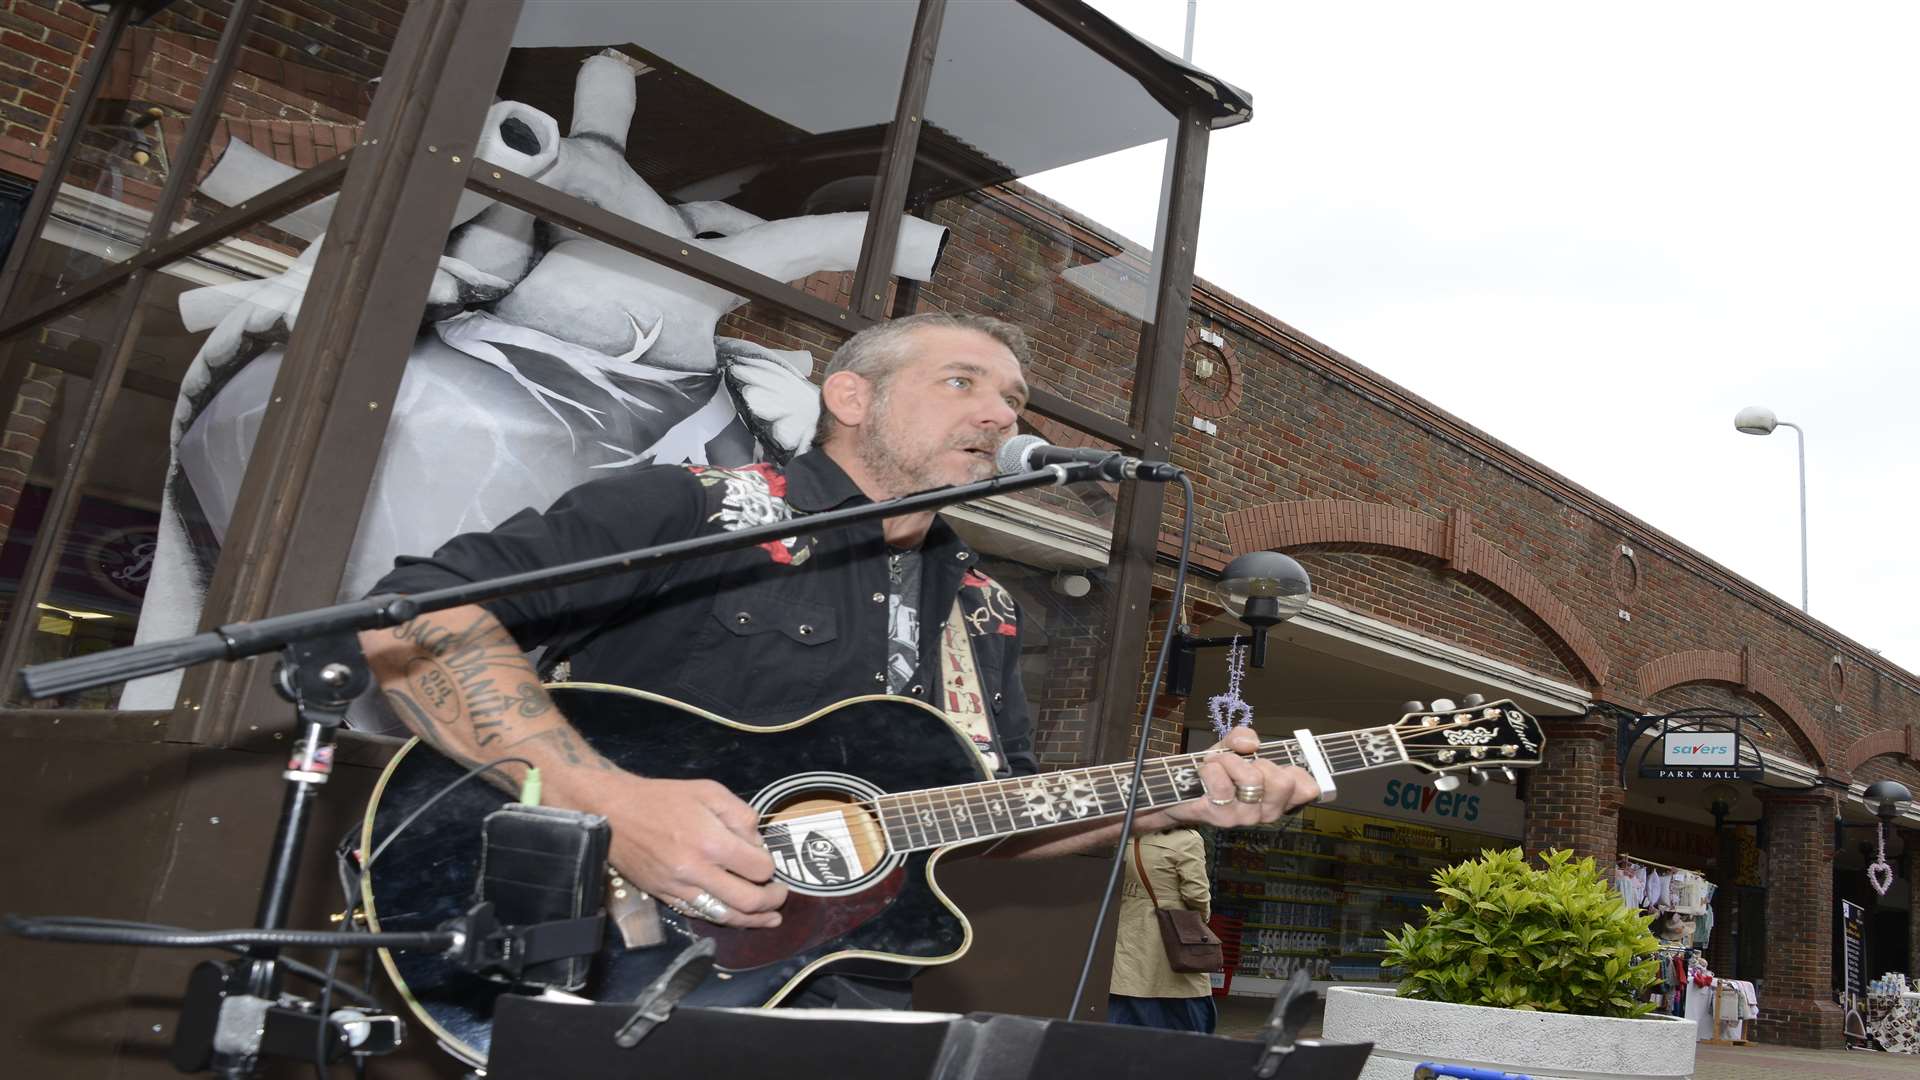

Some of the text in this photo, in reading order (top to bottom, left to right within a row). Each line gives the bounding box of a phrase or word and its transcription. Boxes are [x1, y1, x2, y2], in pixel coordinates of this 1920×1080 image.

[1672, 743, 1728, 754] savers
[1659, 770, 1740, 779] PARK MALL
[1383, 778, 1481, 821] savers
